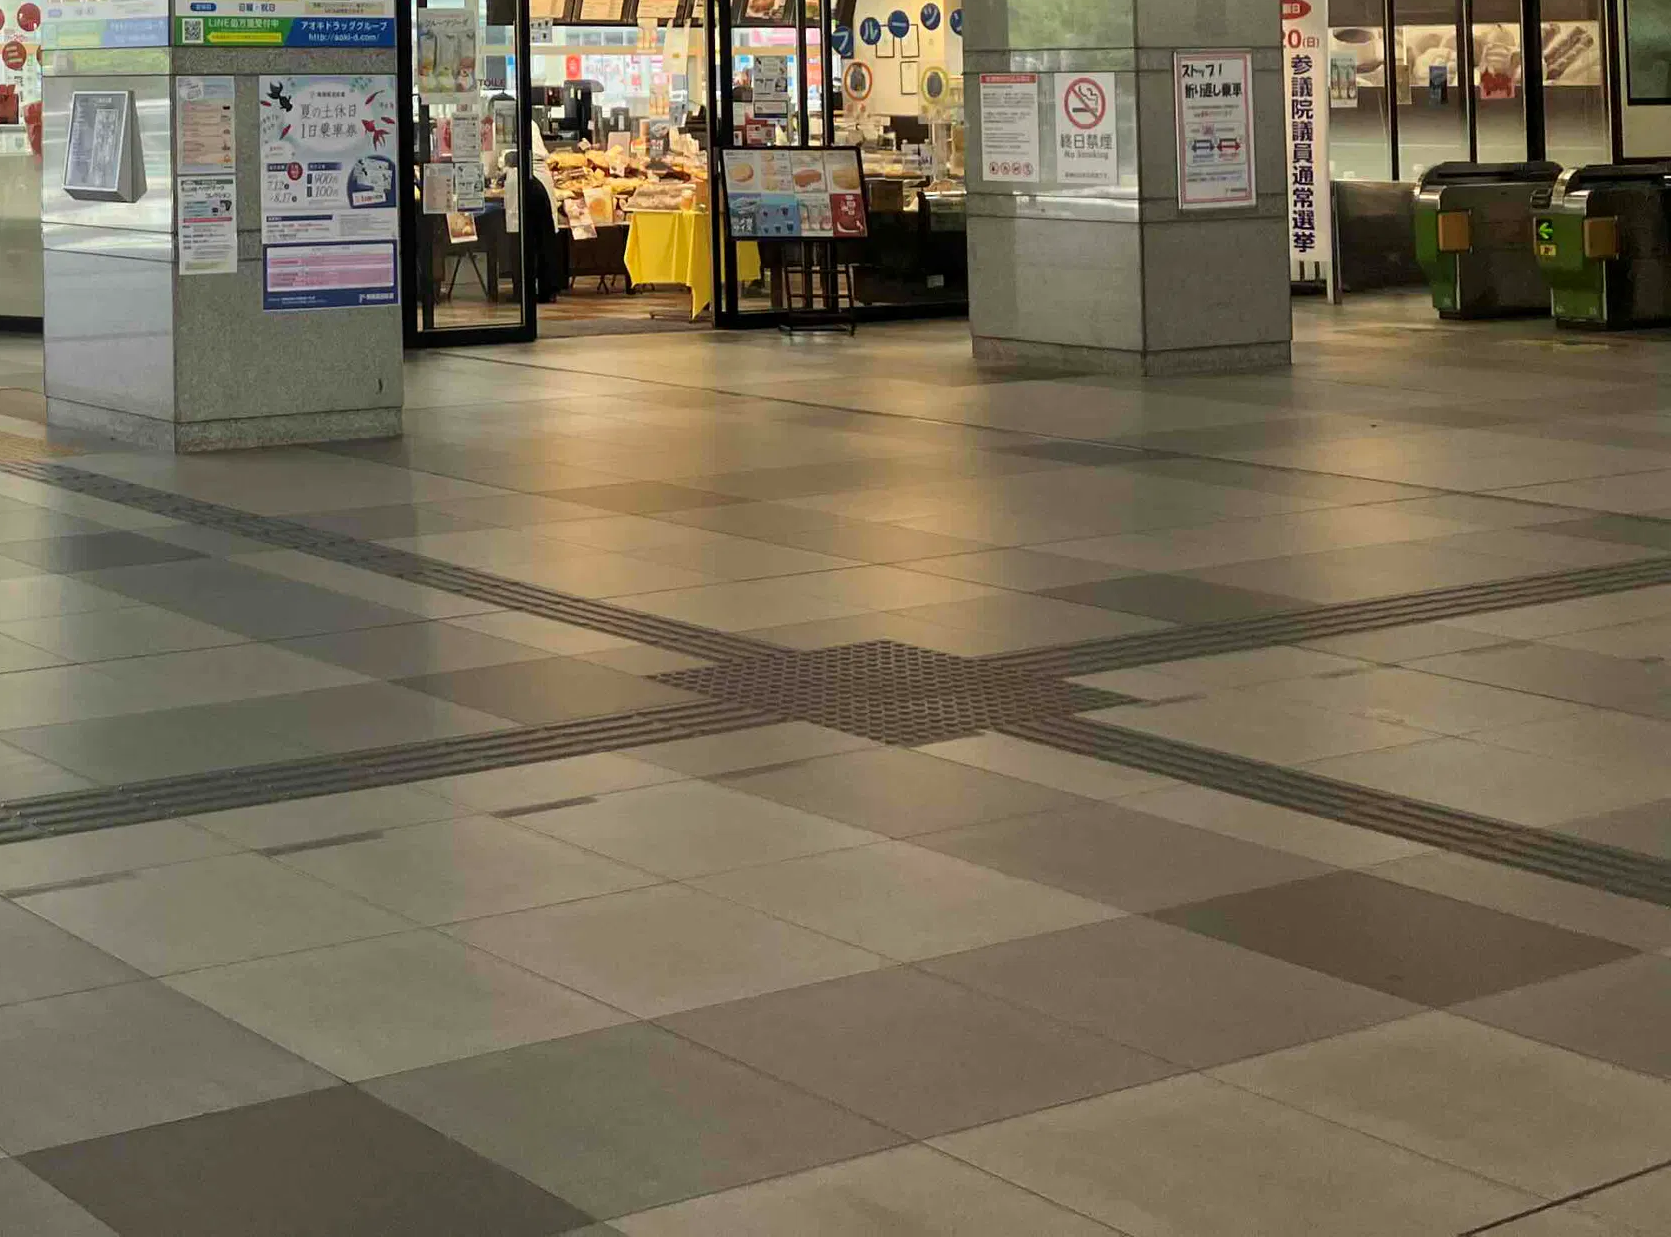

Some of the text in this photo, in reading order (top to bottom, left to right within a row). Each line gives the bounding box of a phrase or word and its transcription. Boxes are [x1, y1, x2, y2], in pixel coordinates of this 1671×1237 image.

[1060, 133, 1113, 150] 終日禁煙
[1290, 53, 1316, 254] 参議院議員通常選挙
